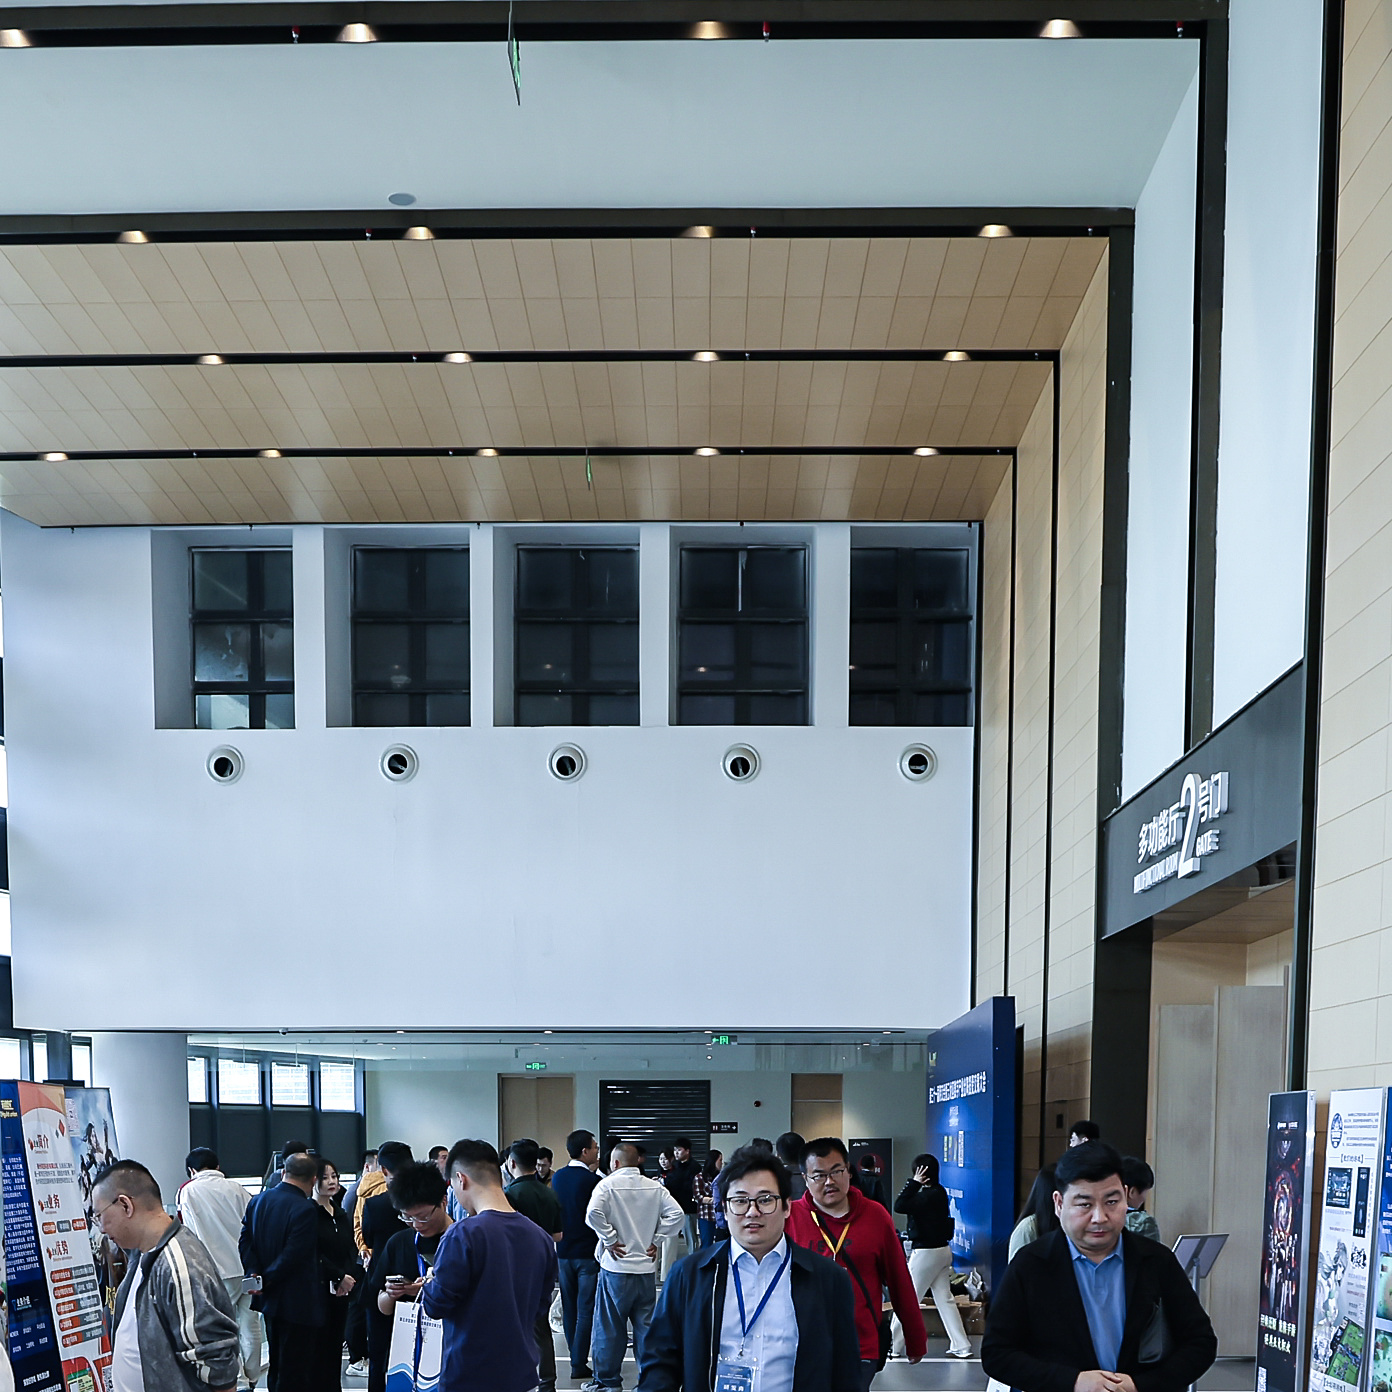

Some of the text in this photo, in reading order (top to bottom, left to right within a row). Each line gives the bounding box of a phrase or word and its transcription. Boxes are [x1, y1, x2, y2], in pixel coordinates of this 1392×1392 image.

[1138, 802, 1185, 863] 多功能厅
[1178, 773, 1202, 879] 2
[1198, 771, 1229, 822] 号门
